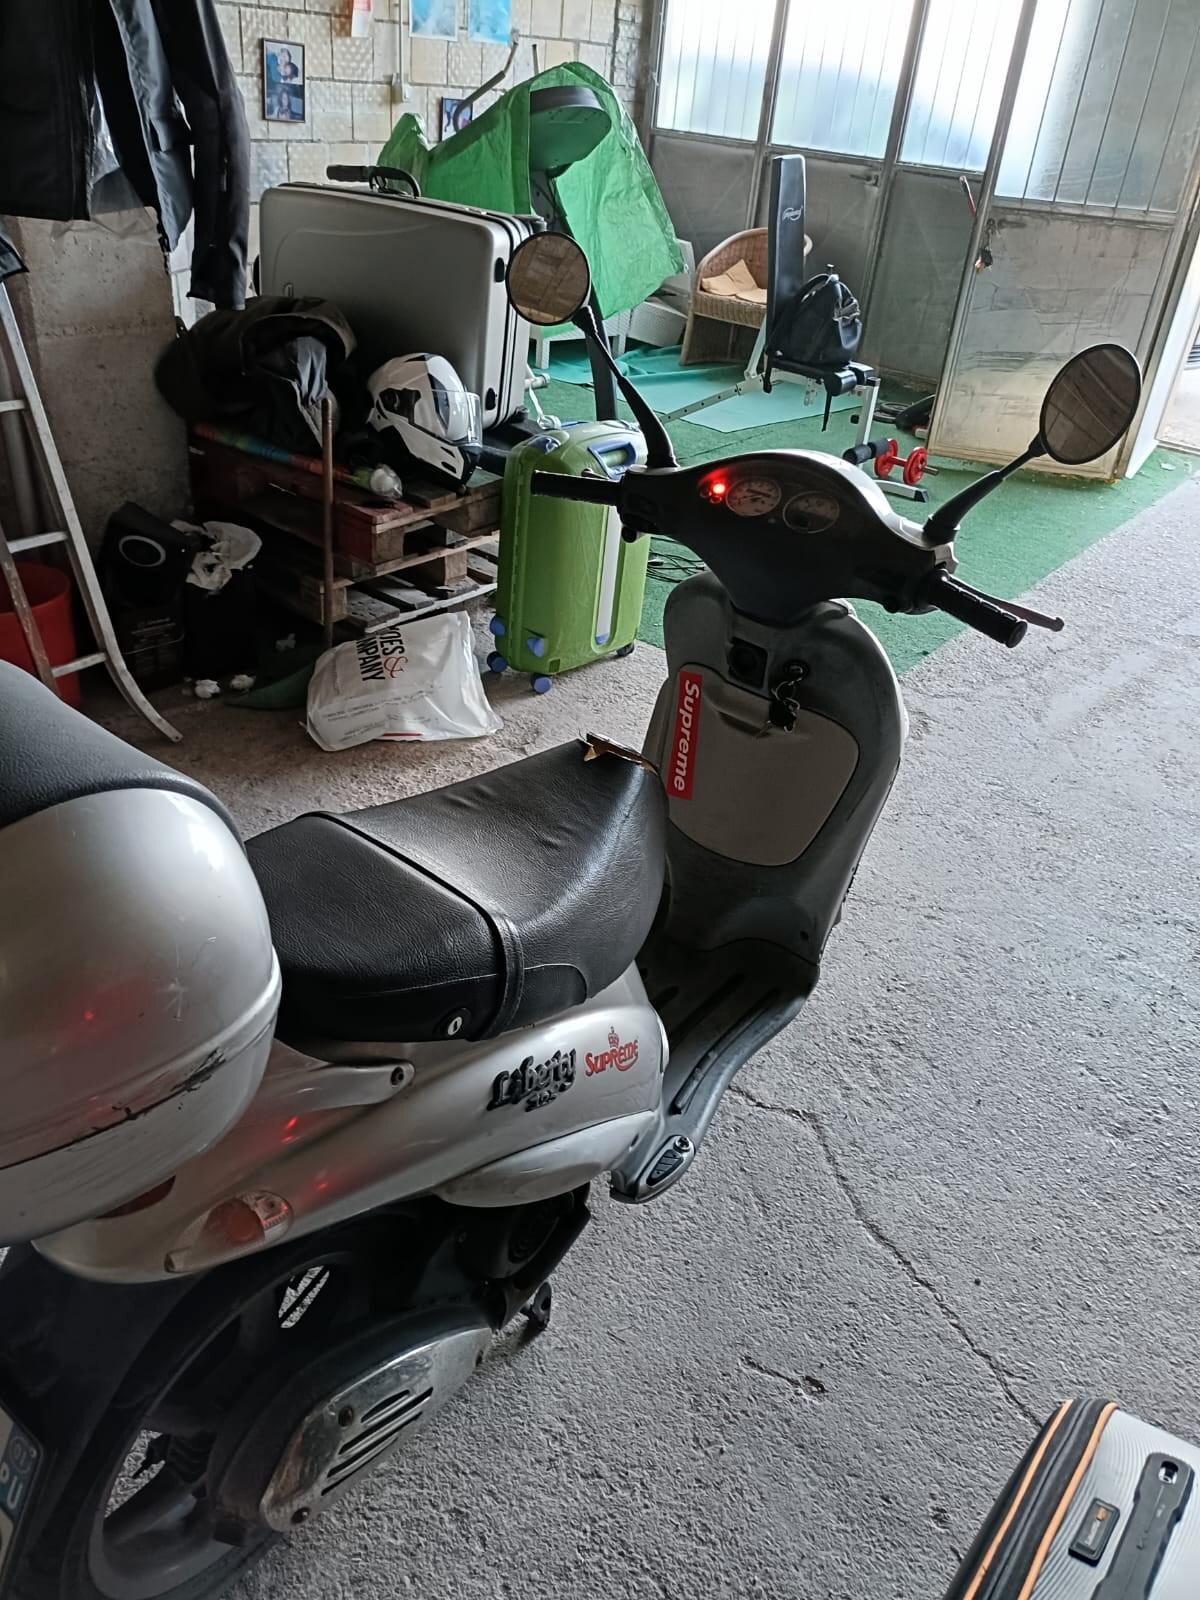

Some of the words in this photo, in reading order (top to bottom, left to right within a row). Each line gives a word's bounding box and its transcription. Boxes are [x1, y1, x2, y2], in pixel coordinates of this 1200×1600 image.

[379, 626, 406, 655] OES
[383, 656, 408, 679] &
[673, 679, 700, 791] Supreme
[487, 1048, 577, 1111] Liberty
